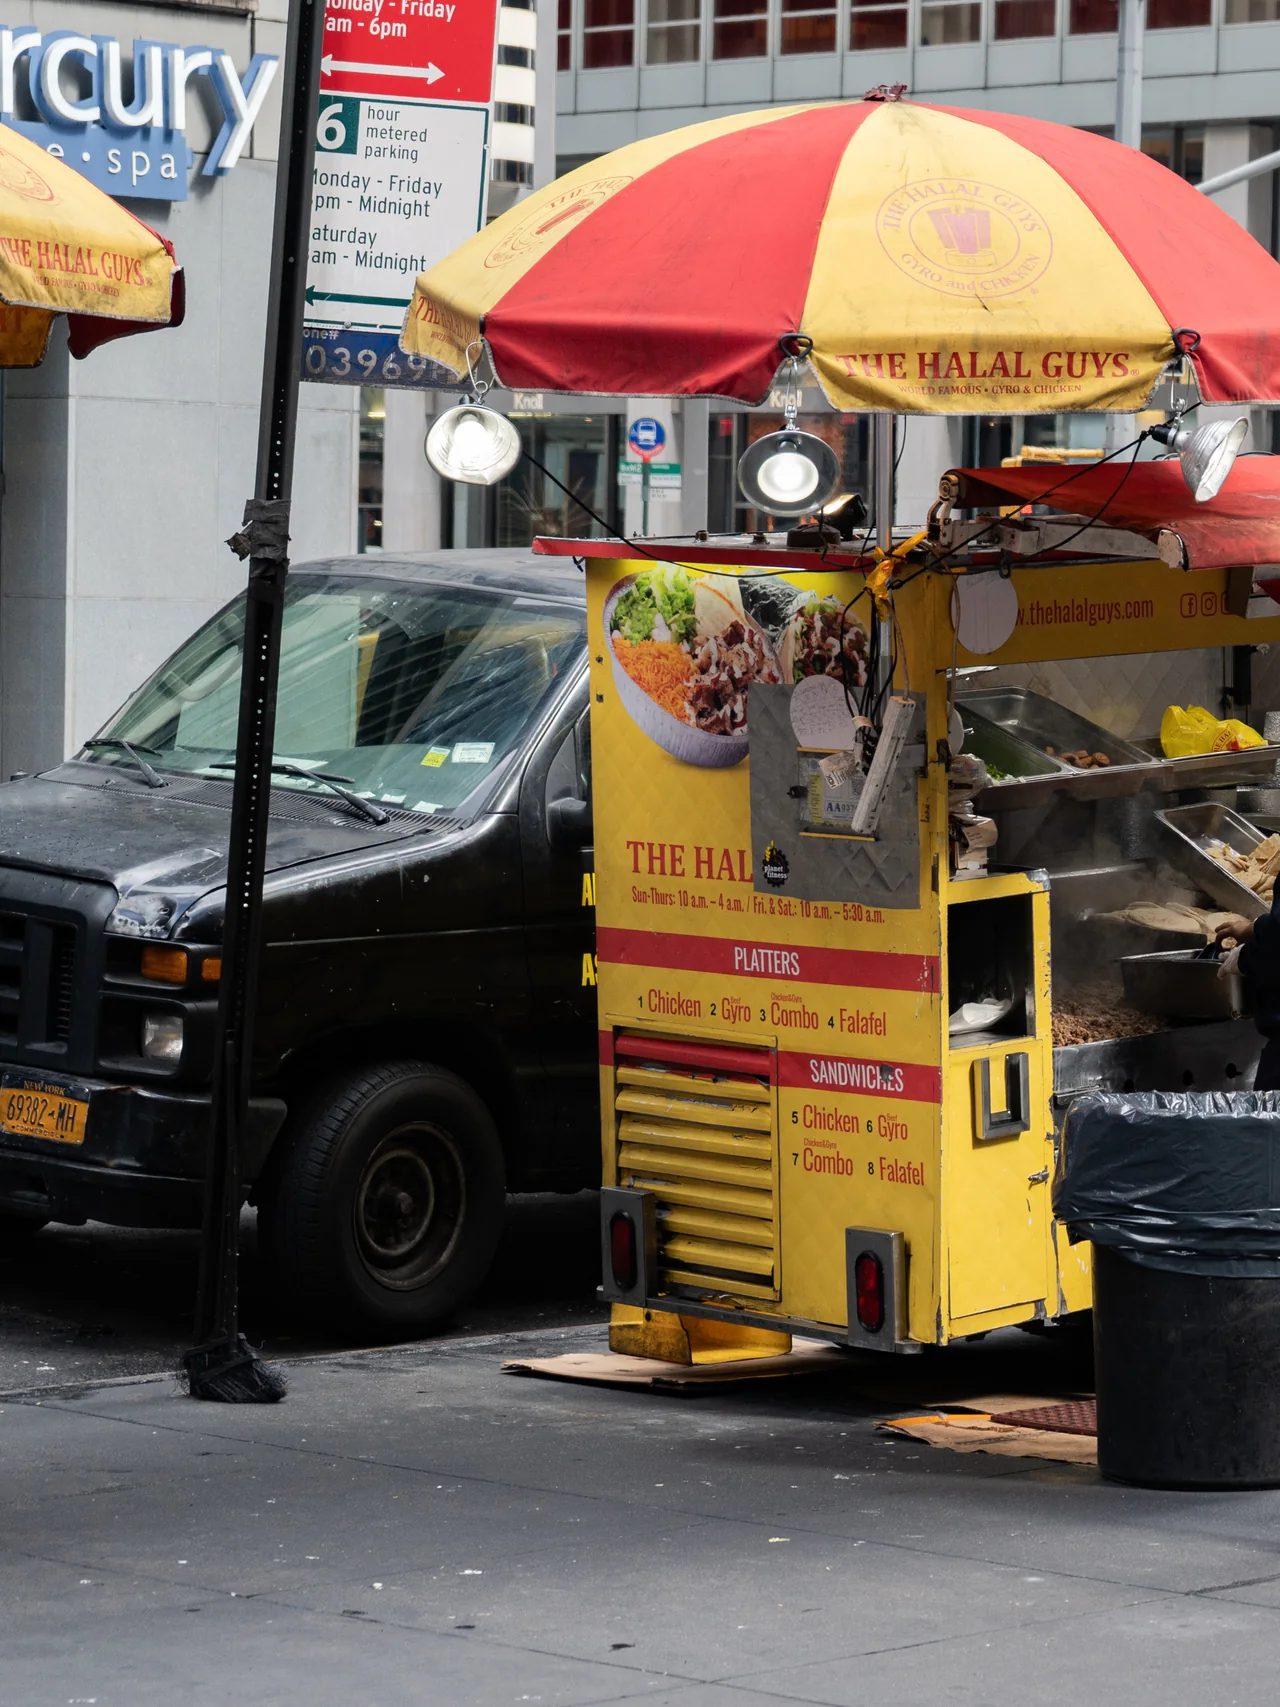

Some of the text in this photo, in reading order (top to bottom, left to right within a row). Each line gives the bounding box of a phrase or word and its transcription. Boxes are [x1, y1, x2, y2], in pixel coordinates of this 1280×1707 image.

[369, 17, 407, 39] 6pm
[316, 102, 347, 150] 6
[367, 105, 401, 121] hour
[366, 125, 428, 143] metered
[107, 147, 178, 187] spa
[364, 144, 419, 164] parking
[389, 174, 443, 199] Friday
[358, 194, 431, 220] Midnight
[881, 181, 1044, 233] THE HALAL GUYS
[311, 223, 378, 250] aturday
[36, 240, 99, 277] HALAL
[355, 249, 427, 275] Midnight
[901, 252, 943, 284] GYRO
[979, 253, 1042, 292] CHICKEN
[415, 295, 441, 326] THE
[835, 352, 907, 380] THE
[917, 351, 1032, 380] HALAL
[513, 392, 544, 410] Knoll
[899, 383, 1083, 396] WORLD FAMOUS GYRO & CHICKEN
[626, 840, 687, 878] THE
[763, 863, 784, 875] planet
[766, 868, 788, 880] fitness
[631, 885, 676, 906] Sun-Thurs:
[677, 889, 689, 907] 10
[691, 894, 709, 910] a.m.
[717, 893, 725, 911] 4
[726, 898, 745, 913] a.m.
[752, 896, 768, 915] Fri.
[769, 898, 776, 916] &
[799, 900, 811, 919] 10
[812, 905, 832, 920] a.m.
[842, 904, 864, 923] 5:30
[864, 909, 885, 924] a.m.
[734, 946, 801, 977] PLATTERS
[638, 988, 888, 1037] 1 Chicken 2 Gyro 3 Combo 4 Falafel
[23, 1080, 66, 1096] NEW YORK
[15, 1124, 61, 1139] COMMERCIAL
[791, 1103, 909, 1143] 5 Chicken 6 Gyro
[791, 1147, 925, 1186] 7 Combo 8 Falafel
